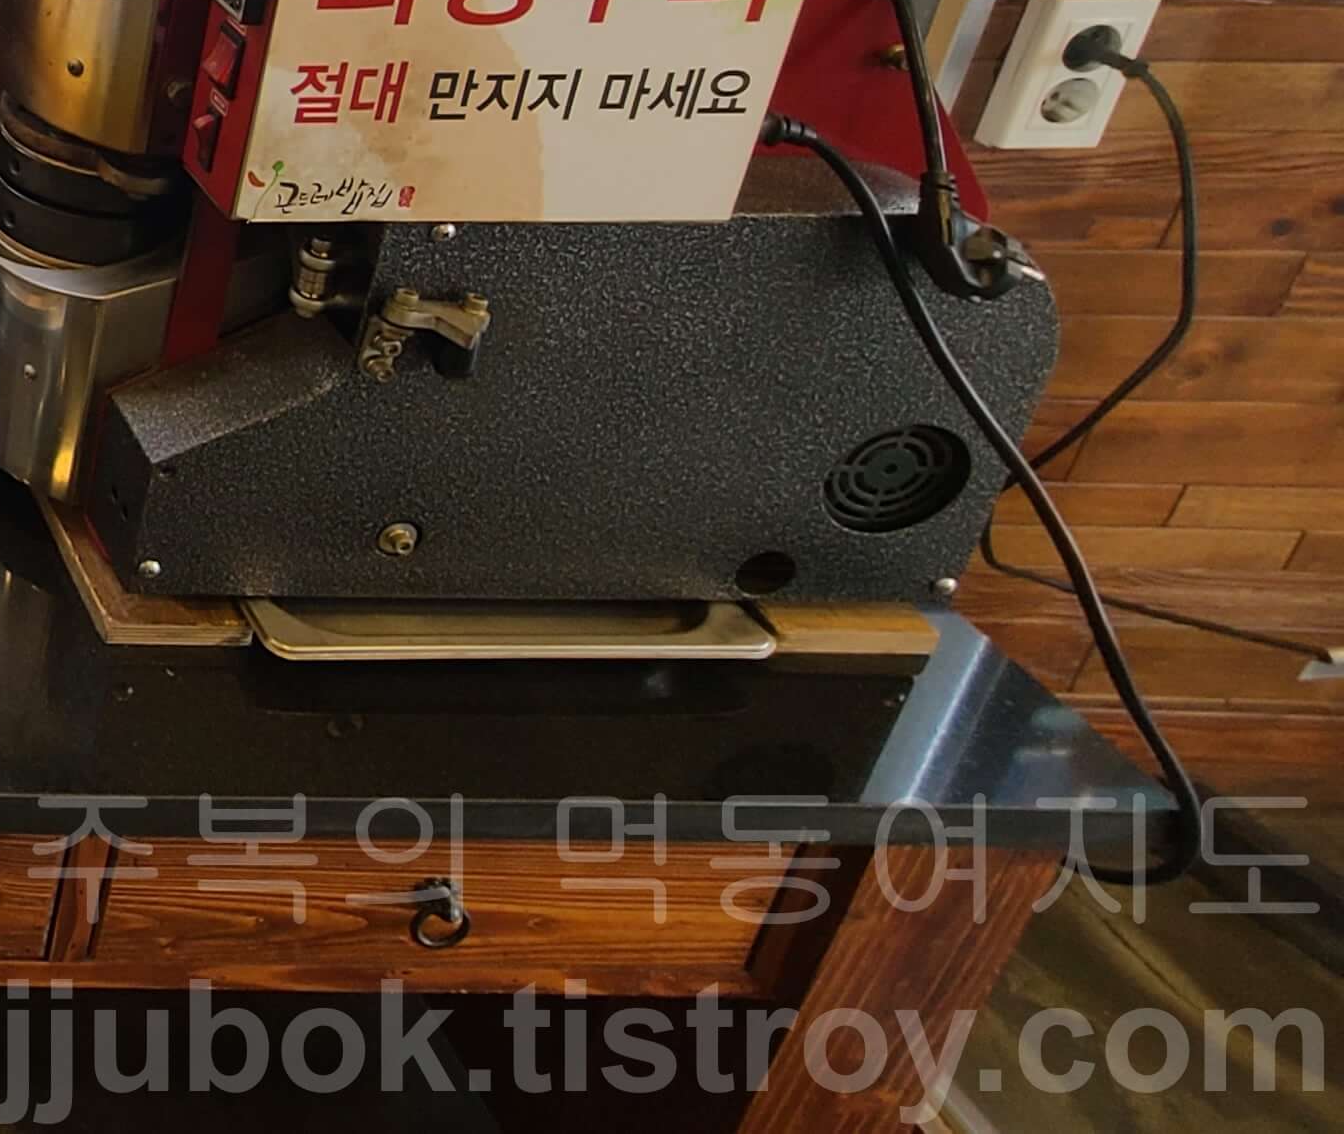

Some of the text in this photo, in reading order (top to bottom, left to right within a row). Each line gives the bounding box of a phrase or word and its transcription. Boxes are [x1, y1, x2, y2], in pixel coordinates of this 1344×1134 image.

[289, 60, 409, 124] 절대
[428, 68, 583, 121] 만지지
[598, 68, 751, 120] 마세요
